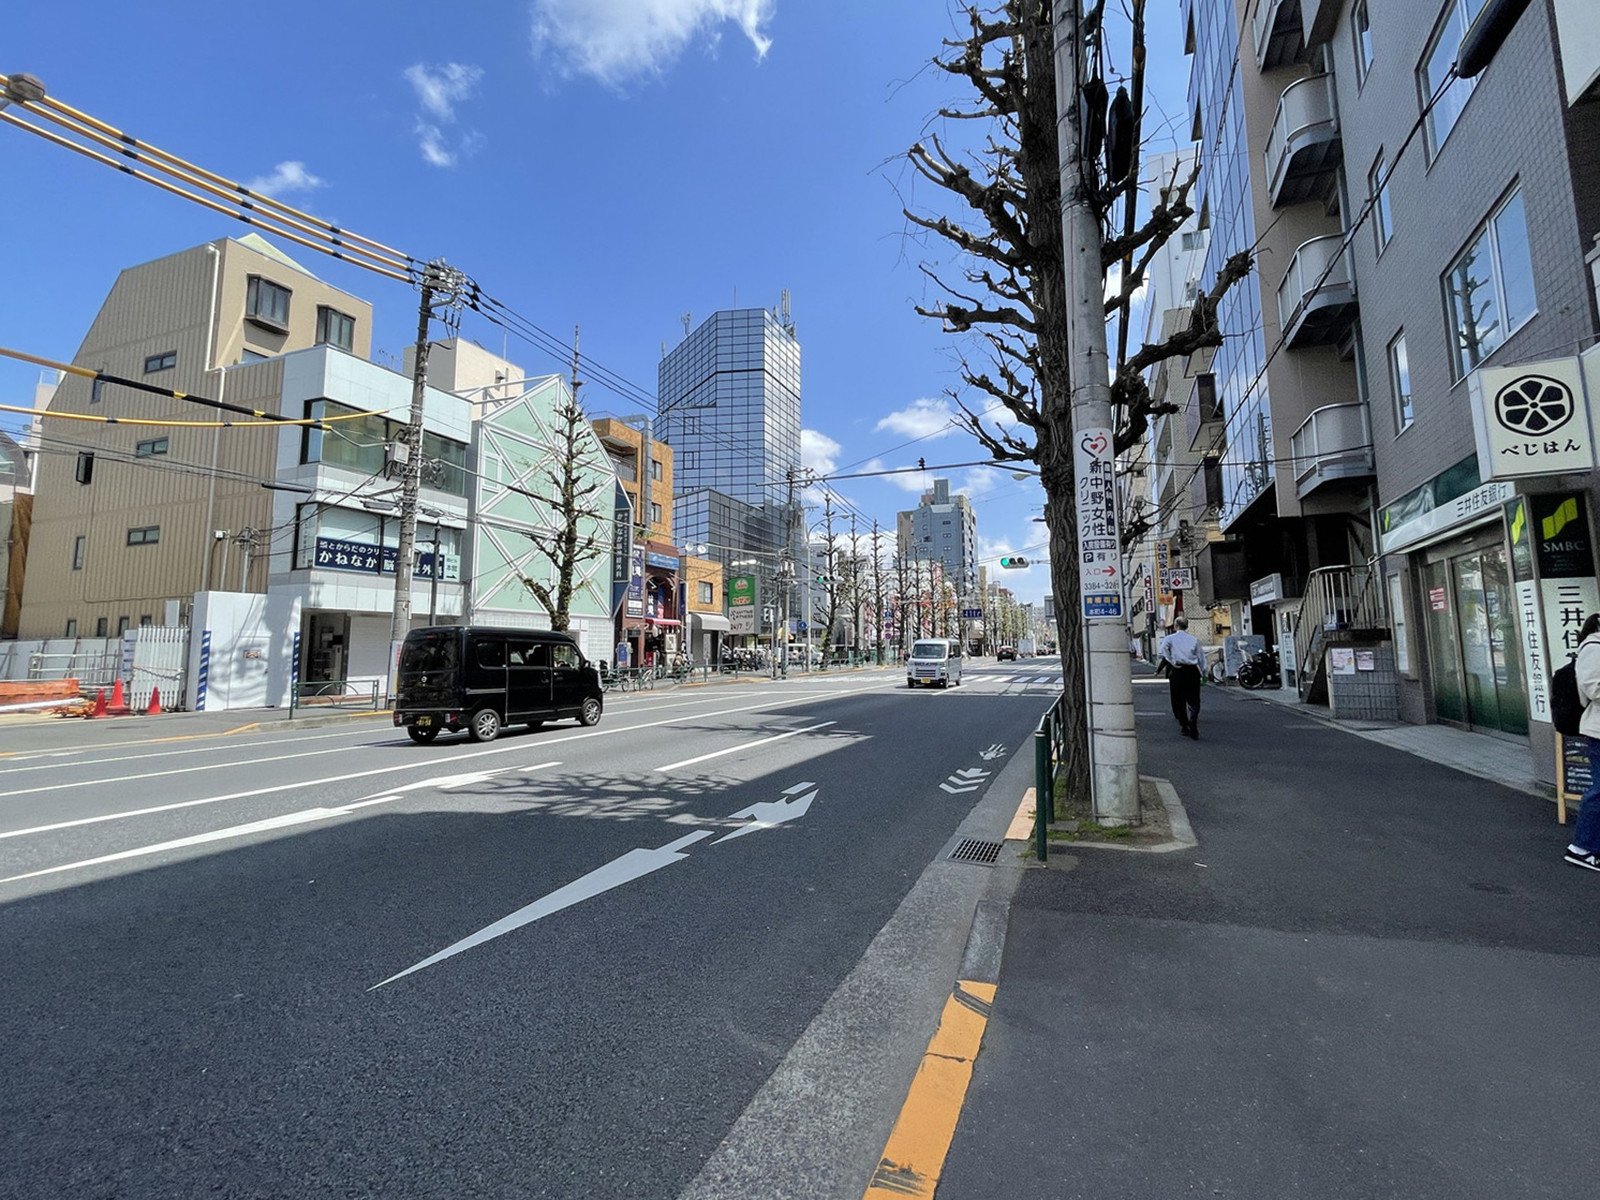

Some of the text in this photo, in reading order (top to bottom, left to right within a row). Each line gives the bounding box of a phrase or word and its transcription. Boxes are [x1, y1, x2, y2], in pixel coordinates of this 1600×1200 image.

[1501, 438, 1581, 456] べじはん
[1080, 476, 1092, 538] クリニック
[1089, 458, 1105, 537] 新中野女性
[1456, 484, 1507, 518] 三井住友銀行
[1543, 540, 1585, 553] SMBC
[1085, 568, 1101, 576] 入口
[1557, 585, 1585, 658] 三井住
[1522, 587, 1546, 714] 三井住友銀行
